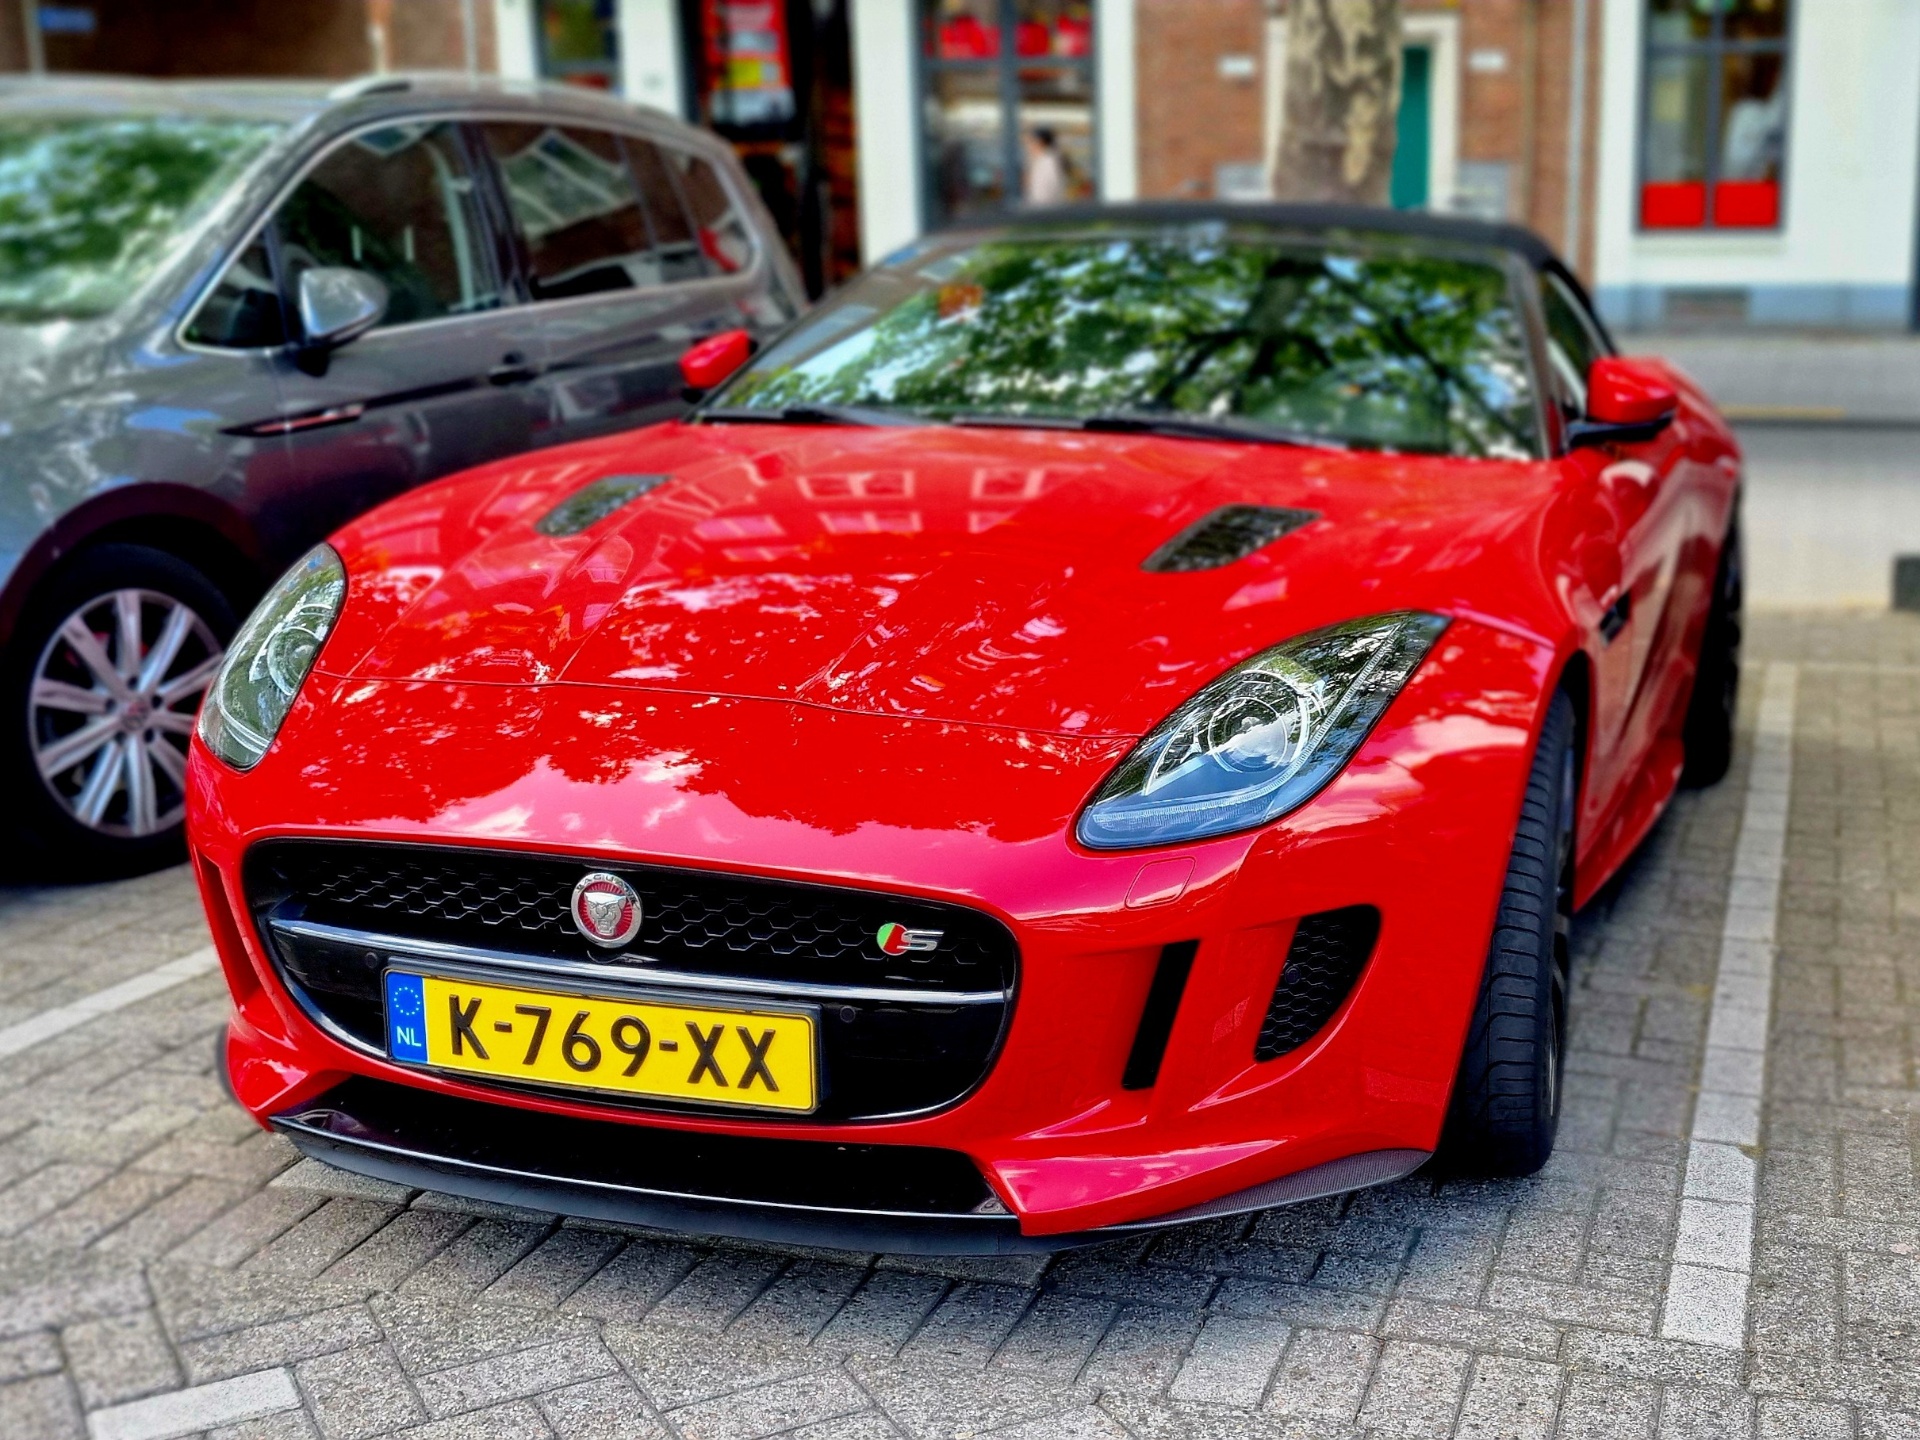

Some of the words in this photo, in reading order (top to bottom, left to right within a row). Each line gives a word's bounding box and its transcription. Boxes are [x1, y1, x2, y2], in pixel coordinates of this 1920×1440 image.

[896, 929, 944, 951] S
[397, 1026, 421, 1046] NL
[449, 994, 779, 1091] K-769-XX
